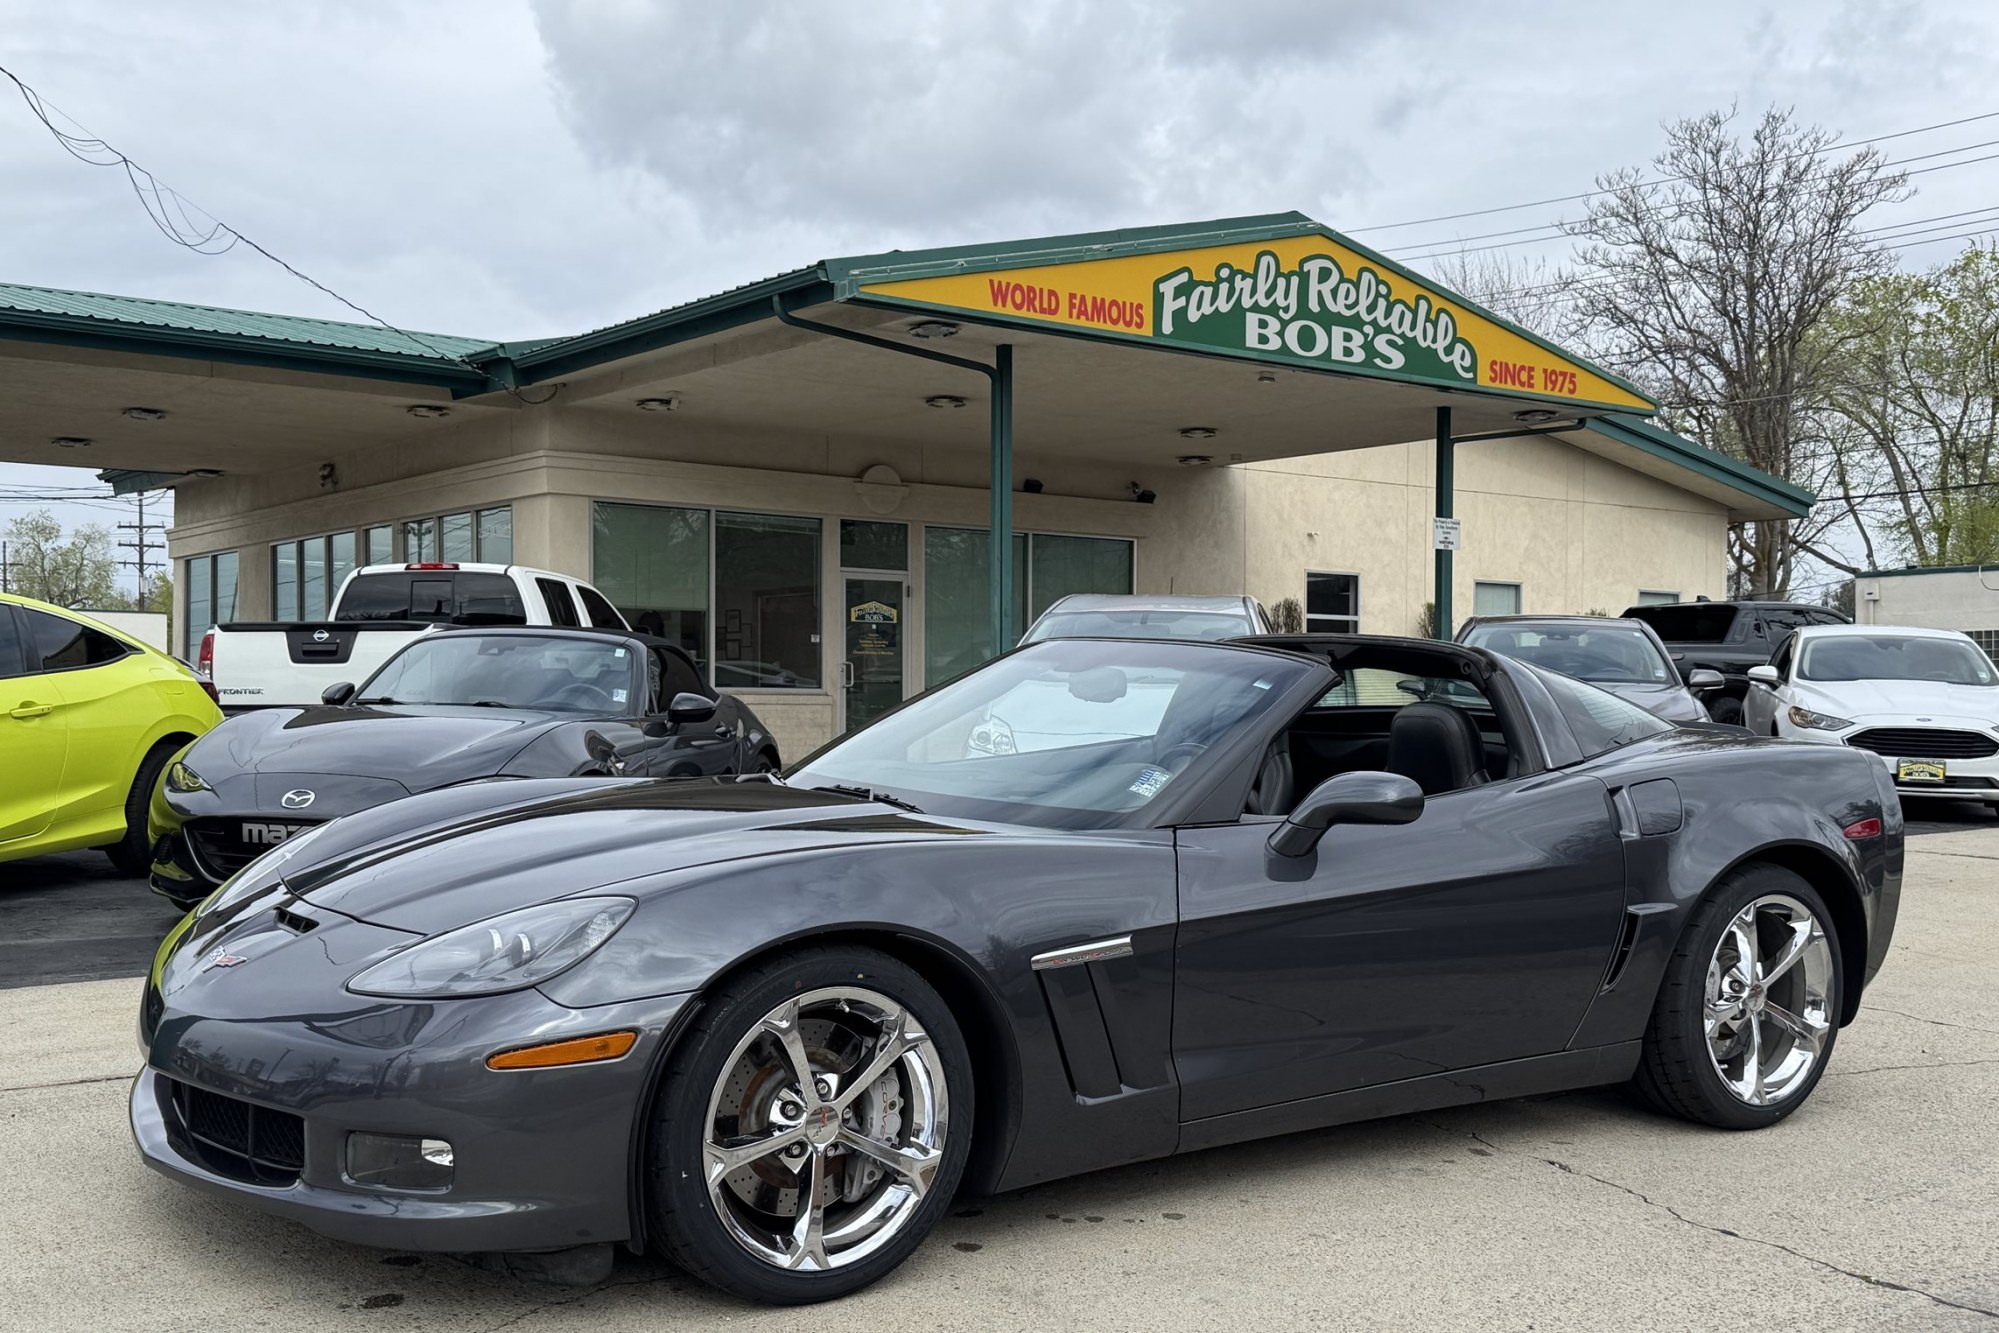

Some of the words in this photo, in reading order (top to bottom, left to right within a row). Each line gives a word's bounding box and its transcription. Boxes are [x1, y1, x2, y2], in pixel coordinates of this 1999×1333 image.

[988, 279, 1060, 316] WORLD
[1068, 292, 1145, 329] FAMOUS
[1159, 255, 1299, 335] Fairly
[1303, 258, 1474, 378] Reliable
[1245, 311, 1406, 370] BOB'S
[1489, 359, 1535, 389] SINCE
[1542, 367, 1577, 395] 1975
[242, 823, 315, 844] maz
